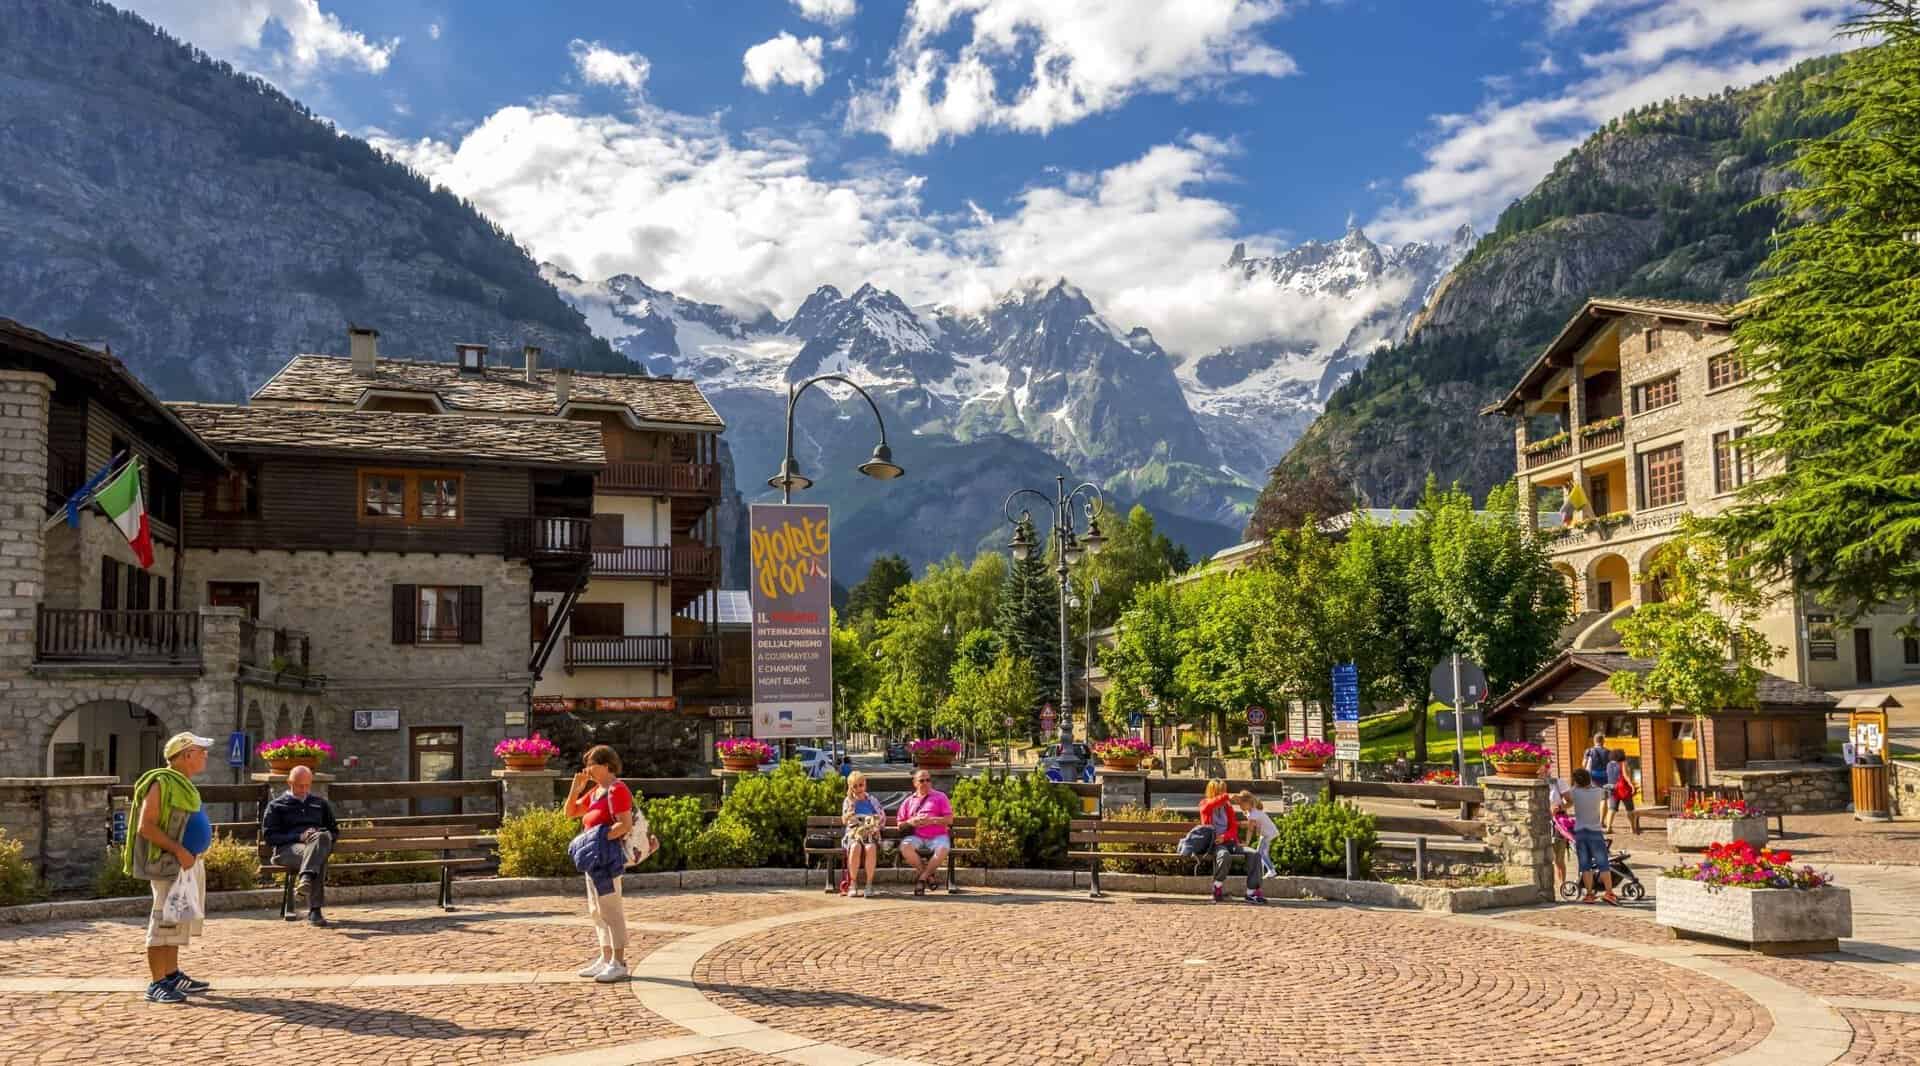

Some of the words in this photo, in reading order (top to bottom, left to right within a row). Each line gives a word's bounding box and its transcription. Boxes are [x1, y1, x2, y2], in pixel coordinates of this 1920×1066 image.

[757, 611, 770, 624] IL
[757, 627, 826, 636] INTERNAZIONALE
[758, 639, 822, 649] DELL'ALPINISMO
